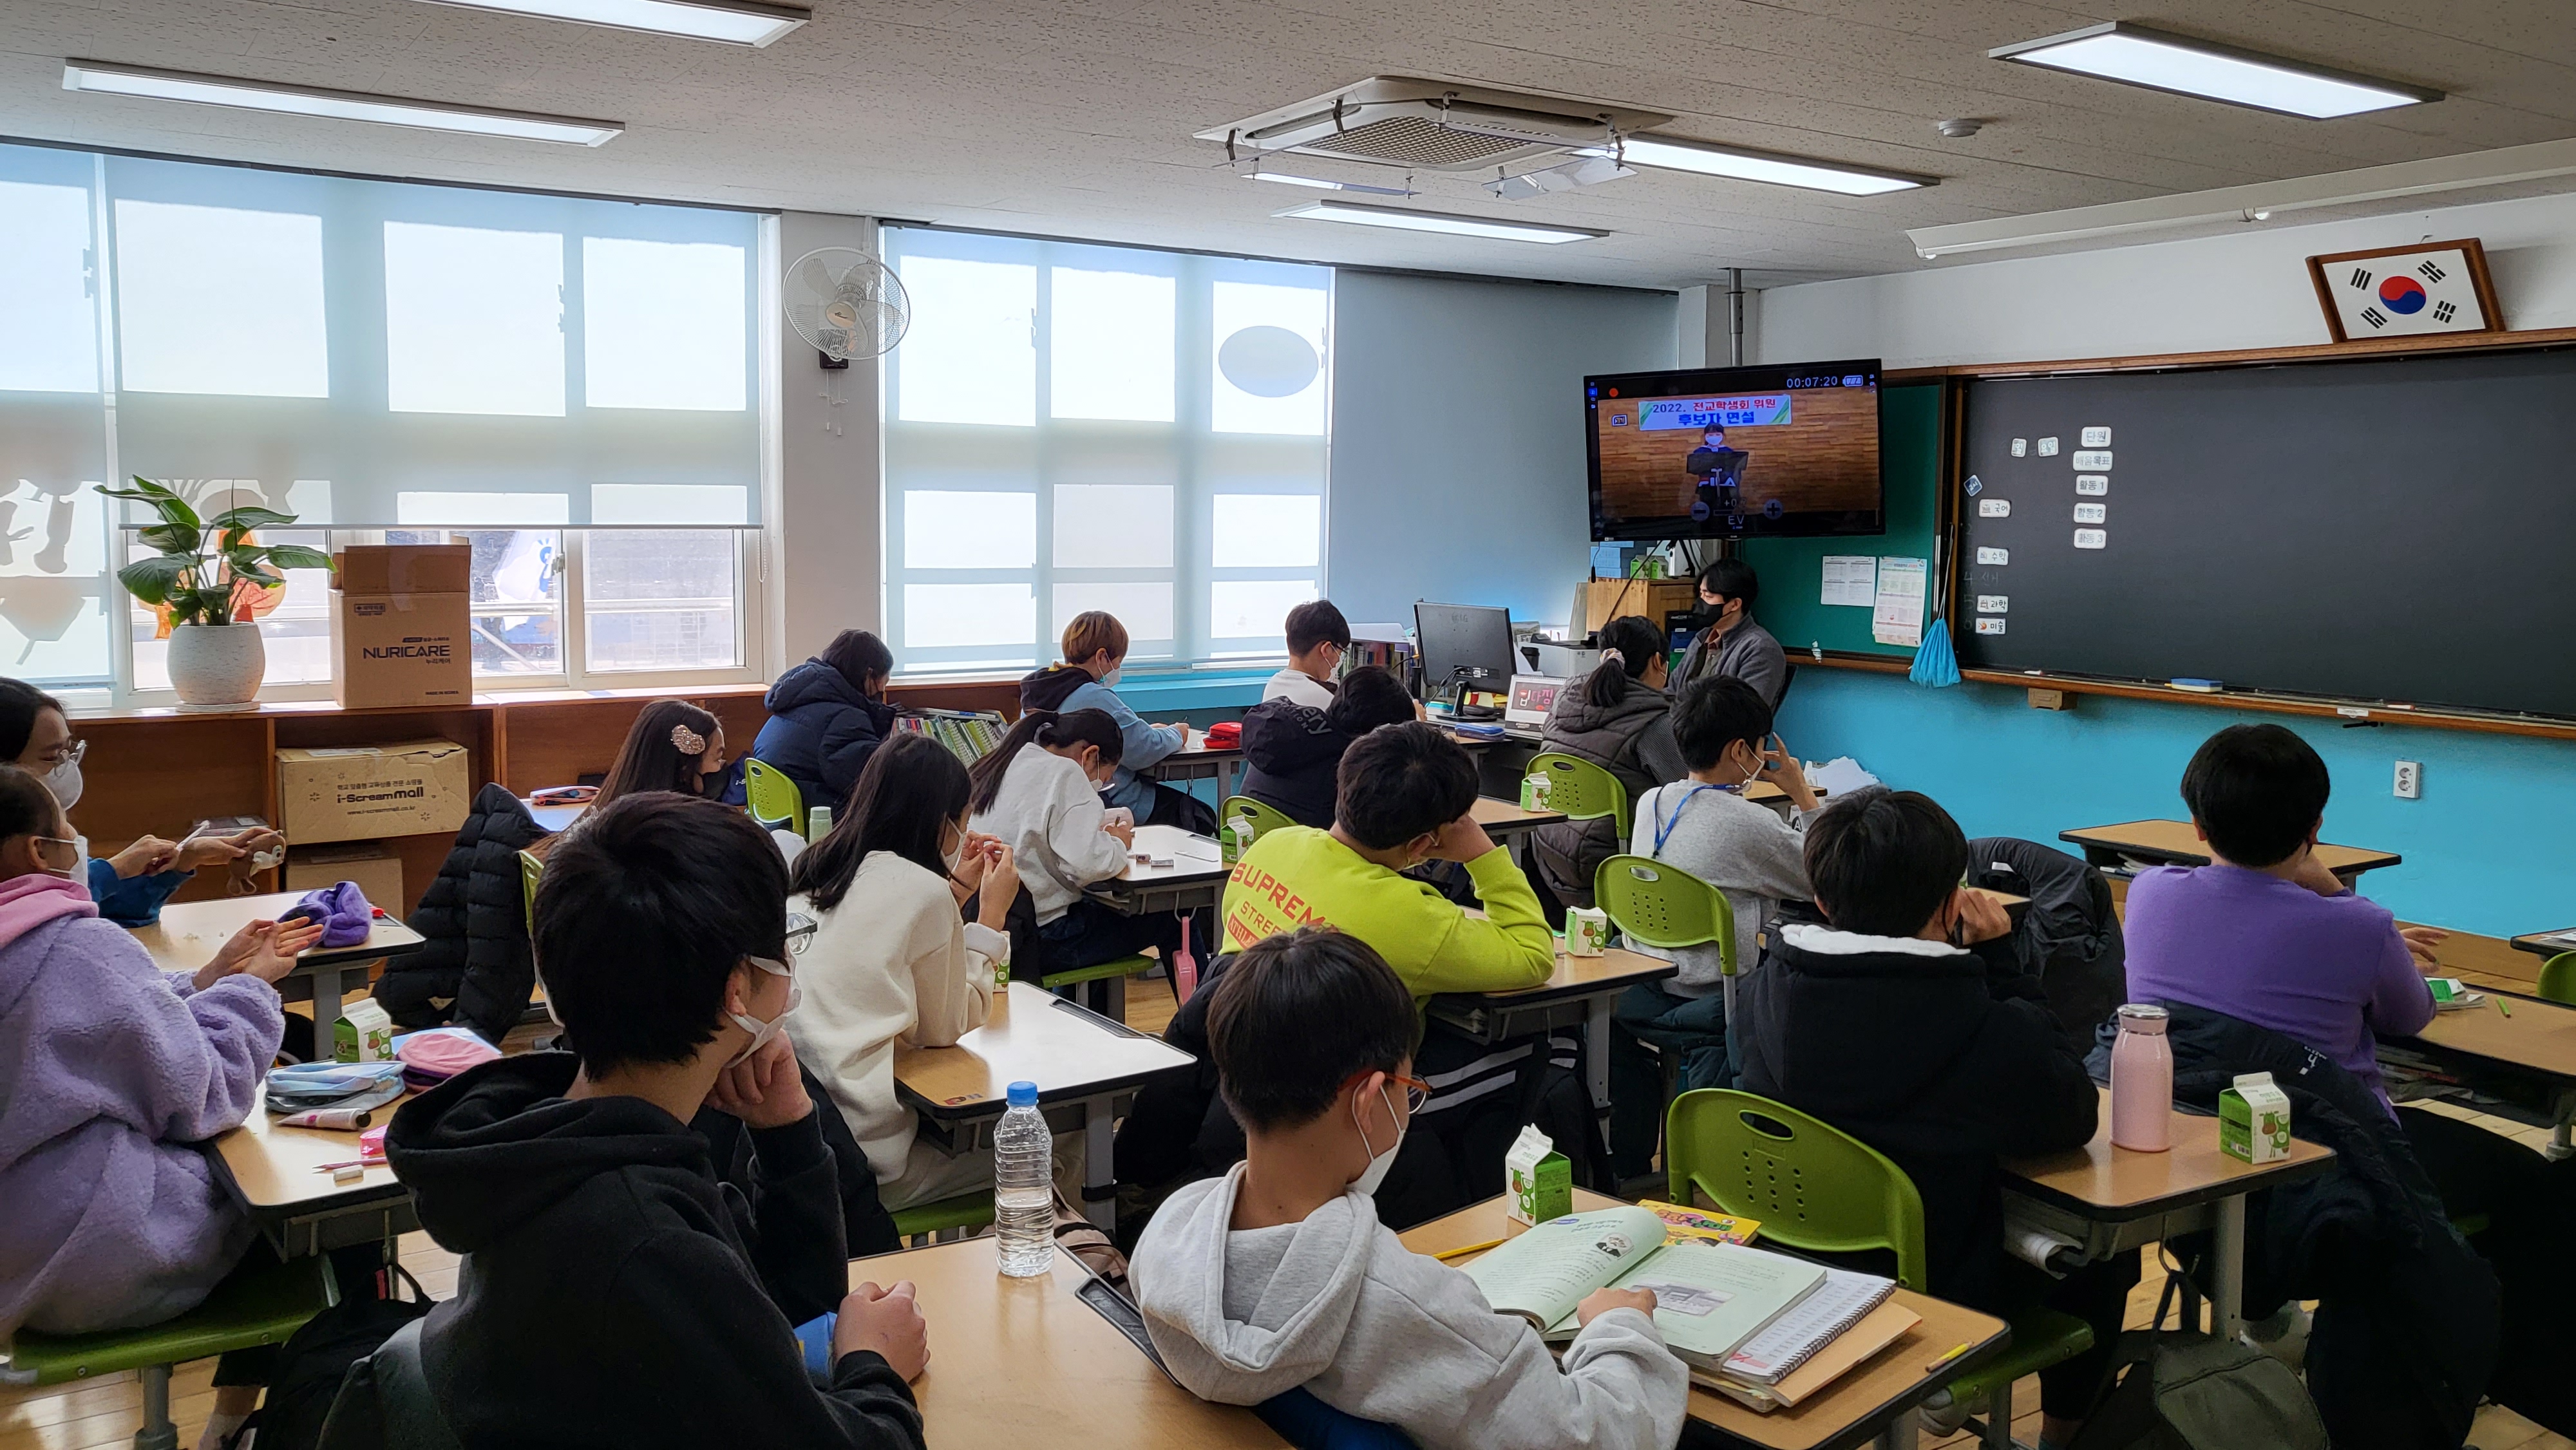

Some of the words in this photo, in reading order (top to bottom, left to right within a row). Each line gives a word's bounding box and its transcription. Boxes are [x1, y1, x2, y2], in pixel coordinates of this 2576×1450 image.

[1786, 376, 1838, 388] 00:07:20
[1653, 403, 1686, 413] 2022.
[1693, 399, 1750, 412] 전교학생회
[1754, 398, 1777, 409] 위원
[1678, 413, 1722, 426] 후보자
[1727, 411, 1755, 424] 연설
[2087, 431, 2107, 442] 단원
[2076, 456, 2110, 466] 배움목표
[2079, 480, 2097, 490] 활동
[1994, 503, 2008, 513] 국어
[2078, 508, 2094, 518] 활동
[2098, 509, 2103, 518] 2
[1728, 515, 1745, 525] EV
[2078, 533, 2094, 543] 활동
[2098, 534, 2103, 543] 3
[1992, 551, 2006, 561] 수학
[1991, 599, 2007, 610] 과학
[1990, 621, 2003, 632] 미술
[363, 645, 450, 659] NURICARE
[1231, 863, 1339, 933] SUPREM
[1240, 901, 1285, 936] STREE
